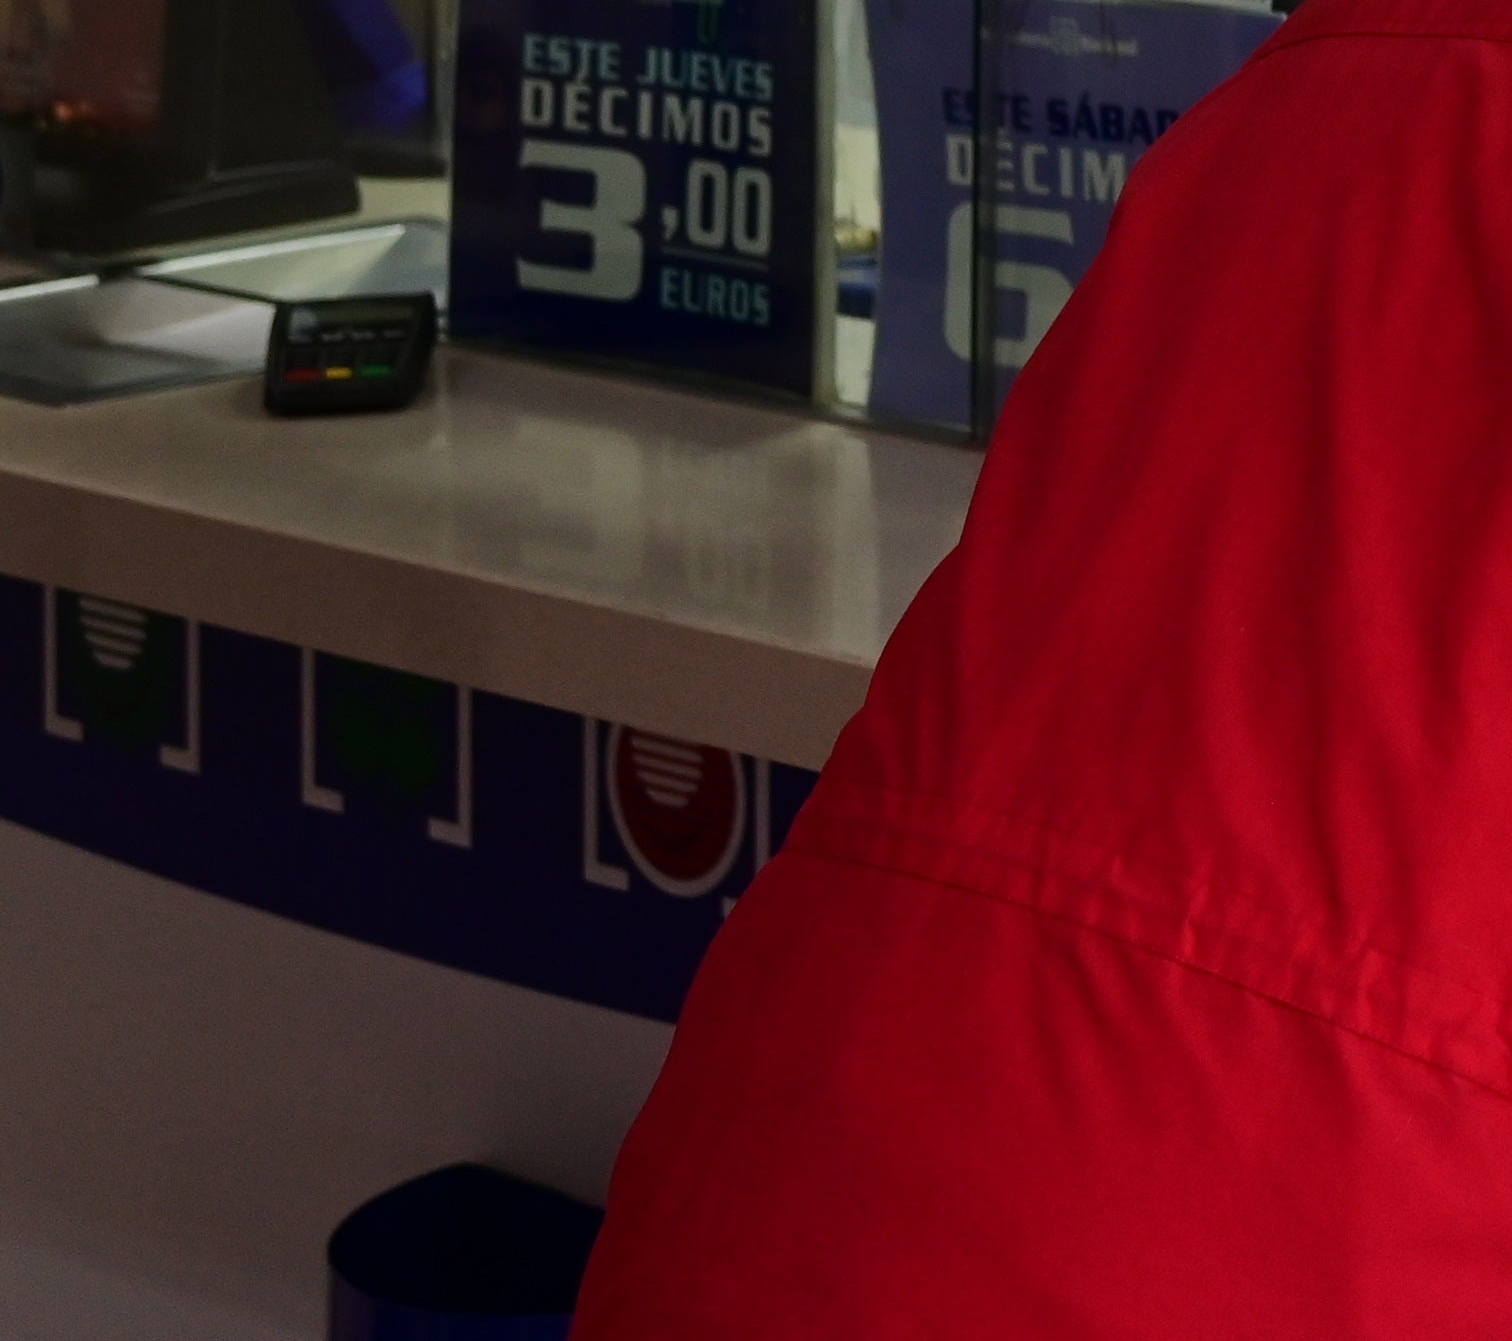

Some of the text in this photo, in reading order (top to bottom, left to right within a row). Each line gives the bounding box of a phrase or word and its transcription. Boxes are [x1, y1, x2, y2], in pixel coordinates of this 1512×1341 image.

[523, 33, 773, 101] ESTE JUEVES
[521, 63, 773, 157] DÉCIMOS
[516, 138, 773, 302] 3,00
[661, 268, 769, 325] EUROS
